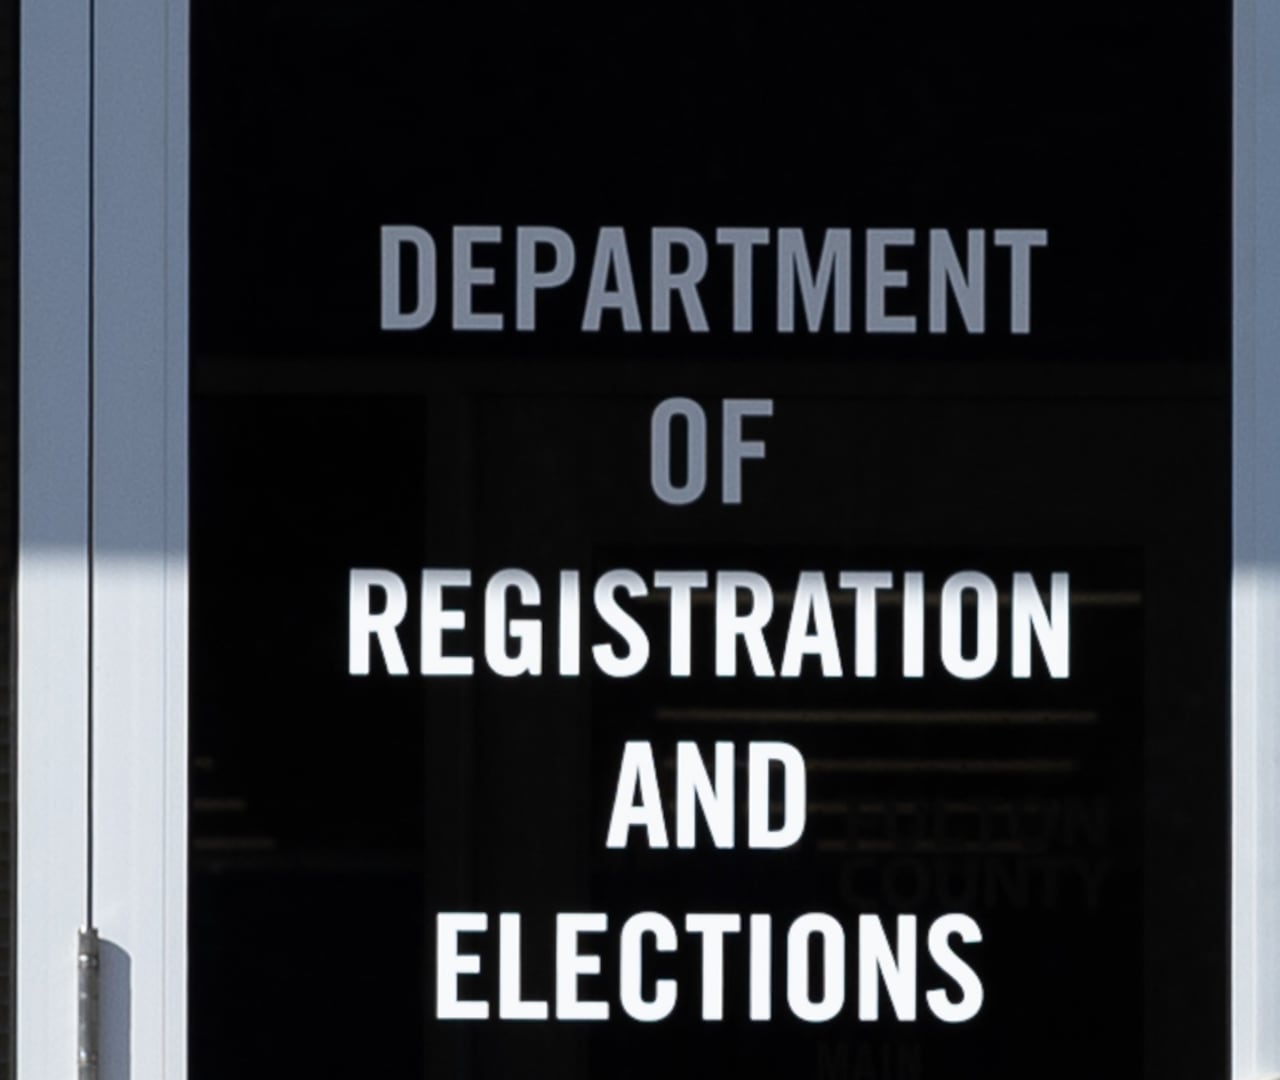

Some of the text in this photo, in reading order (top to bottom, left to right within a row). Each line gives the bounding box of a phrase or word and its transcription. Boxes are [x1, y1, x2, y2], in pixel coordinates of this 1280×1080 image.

[378, 225, 1048, 335] DEPARTMENT
[649, 396, 775, 506] OF
[348, 568, 1071, 681] REGISTRATION
[606, 740, 807, 850] AND
[435, 910, 985, 1024] ELECTIONS
